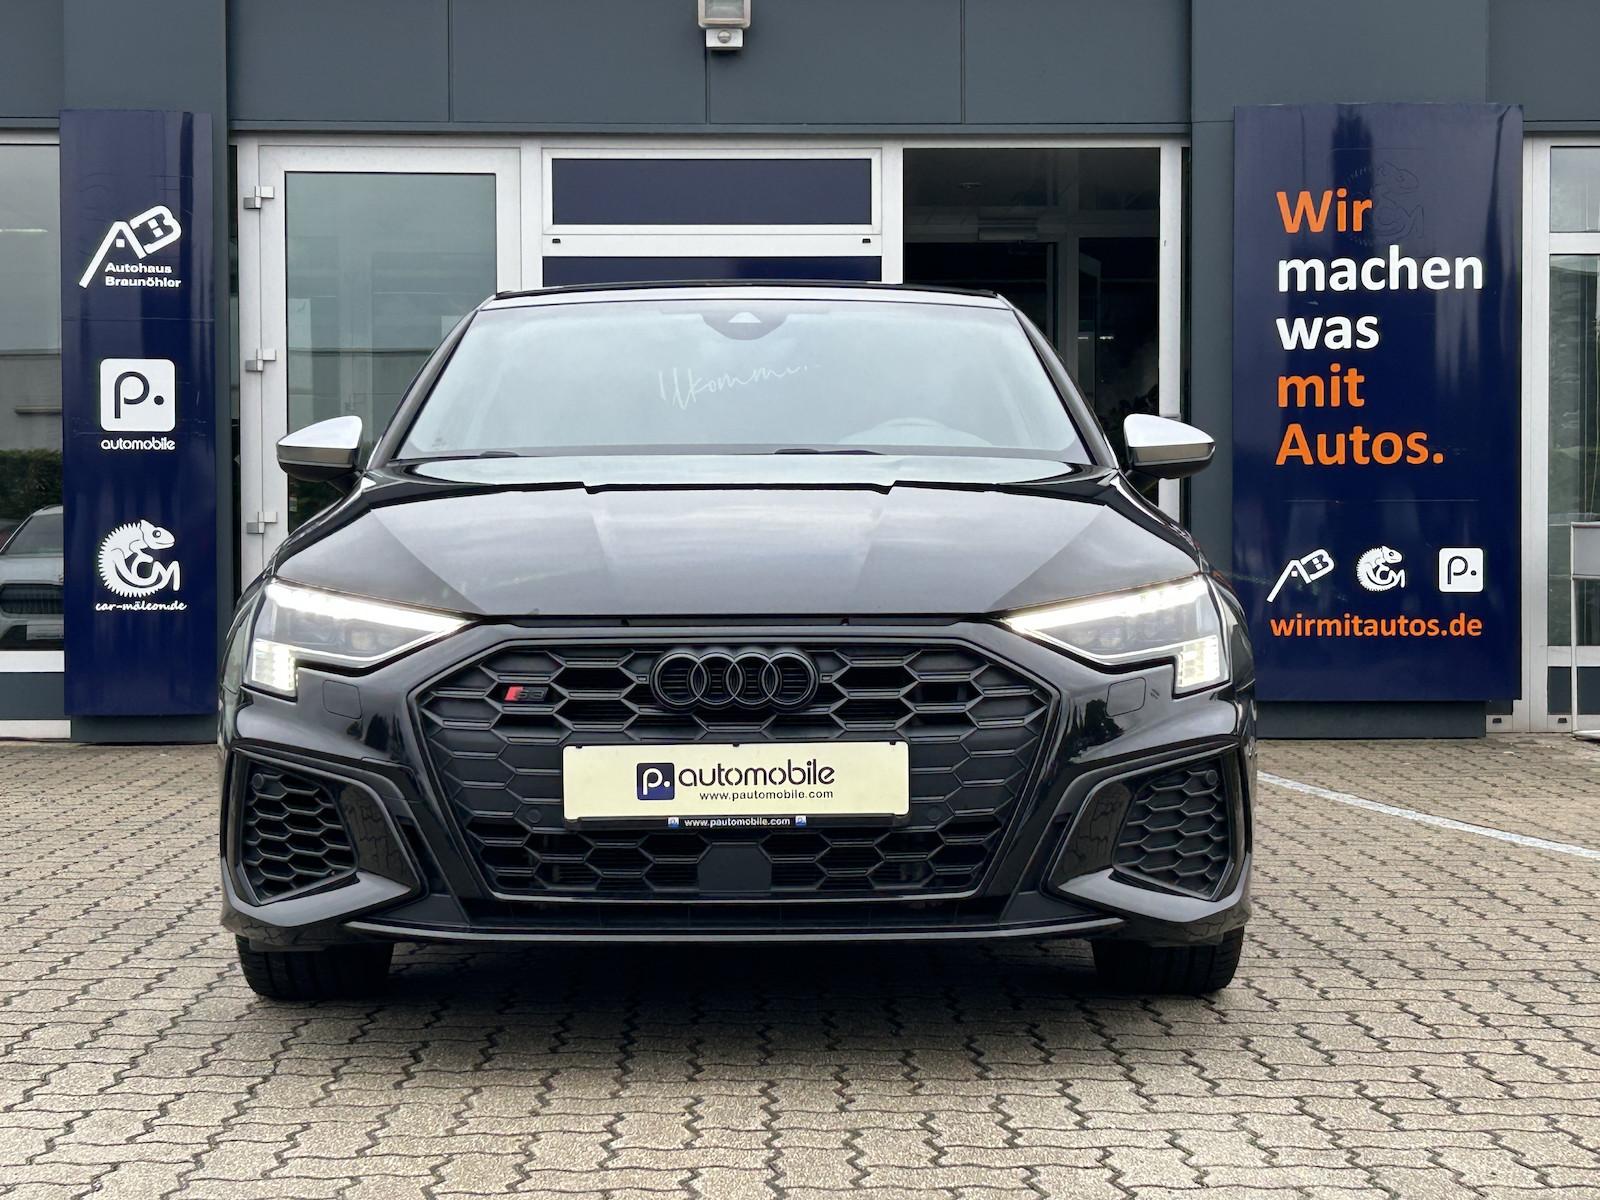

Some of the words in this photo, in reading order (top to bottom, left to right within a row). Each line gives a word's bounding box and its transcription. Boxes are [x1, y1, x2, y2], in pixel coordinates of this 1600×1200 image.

[1276, 188, 1372, 233] Wir
[105, 262, 173, 274] Autohaus
[1278, 244, 1484, 292] machen
[1275, 314, 1380, 350] was
[1278, 363, 1365, 408] mit
[100, 436, 176, 451] automobile
[1275, 423, 1444, 466] Autos.
[1270, 612, 1483, 637] wirmitautos.de
[678, 758, 835, 787] automobile
[699, 788, 834, 802] www.pautomobile.com
[684, 815, 791, 828] www.pautomobile.com
